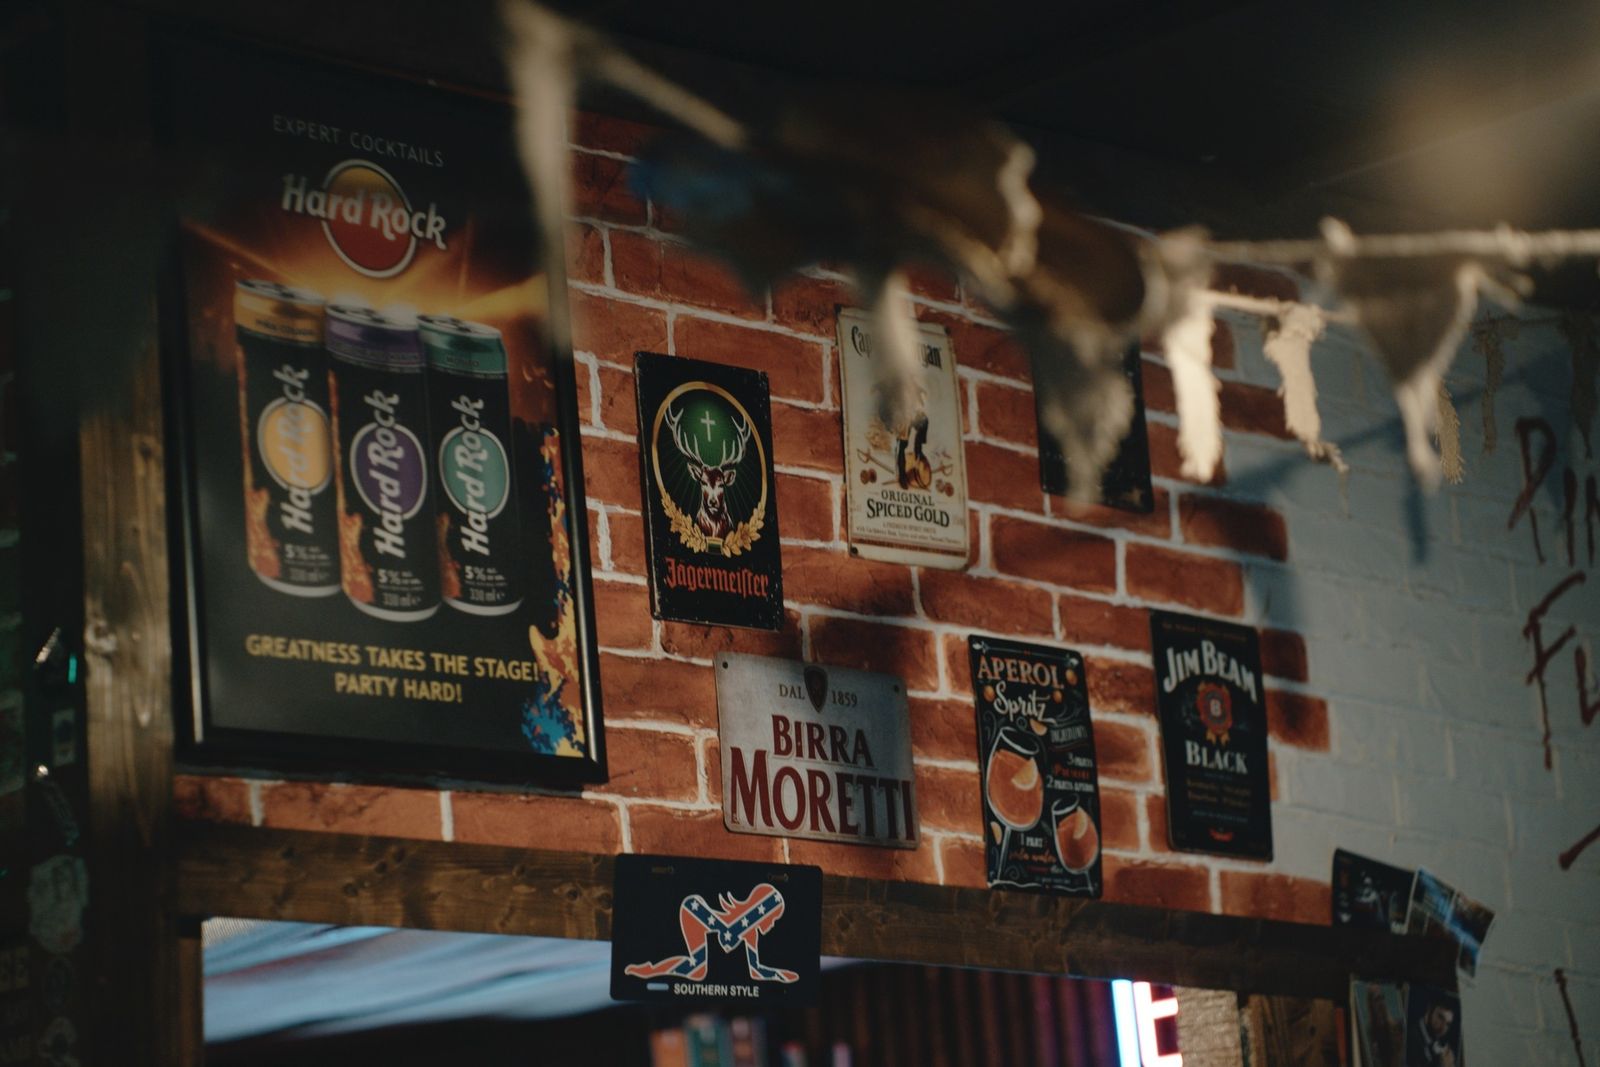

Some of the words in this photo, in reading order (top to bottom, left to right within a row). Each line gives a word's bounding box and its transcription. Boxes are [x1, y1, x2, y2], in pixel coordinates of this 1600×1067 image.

[272, 113, 342, 145] EXPERT
[349, 131, 444, 168] COCKTAILS
[281, 173, 363, 226] Hard
[370, 197, 448, 251] Rock
[363, 389, 405, 471] Rock
[450, 394, 489, 473] Rock
[279, 437, 314, 534] Hard
[881, 489, 935, 507] ORIGINAL
[368, 468, 407, 559] Hard
[456, 471, 491, 556] Hard
[914, 504, 950, 528] GOLD
[246, 634, 361, 665] GREATNESS
[365, 646, 427, 674] TAKES
[430, 653, 470, 677] THE
[473, 657, 541, 683] STAGE!
[977, 655, 1064, 690] APEROL
[1163, 645, 1201, 694] JIM
[1200, 639, 1258, 705] BEAM
[334, 672, 398, 698] PARTY
[403, 680, 463, 704] HARD!
[779, 683, 805, 700] DAL
[831, 690, 858, 708] 1859
[993, 680, 1057, 723] Spritz
[771, 714, 875, 768] BIRRA
[1184, 739, 1249, 775] BLACK
[730, 747, 916, 841] MORETTI
[673, 983, 728, 997] SOUTHERN
[729, 985, 760, 998] STYLE
